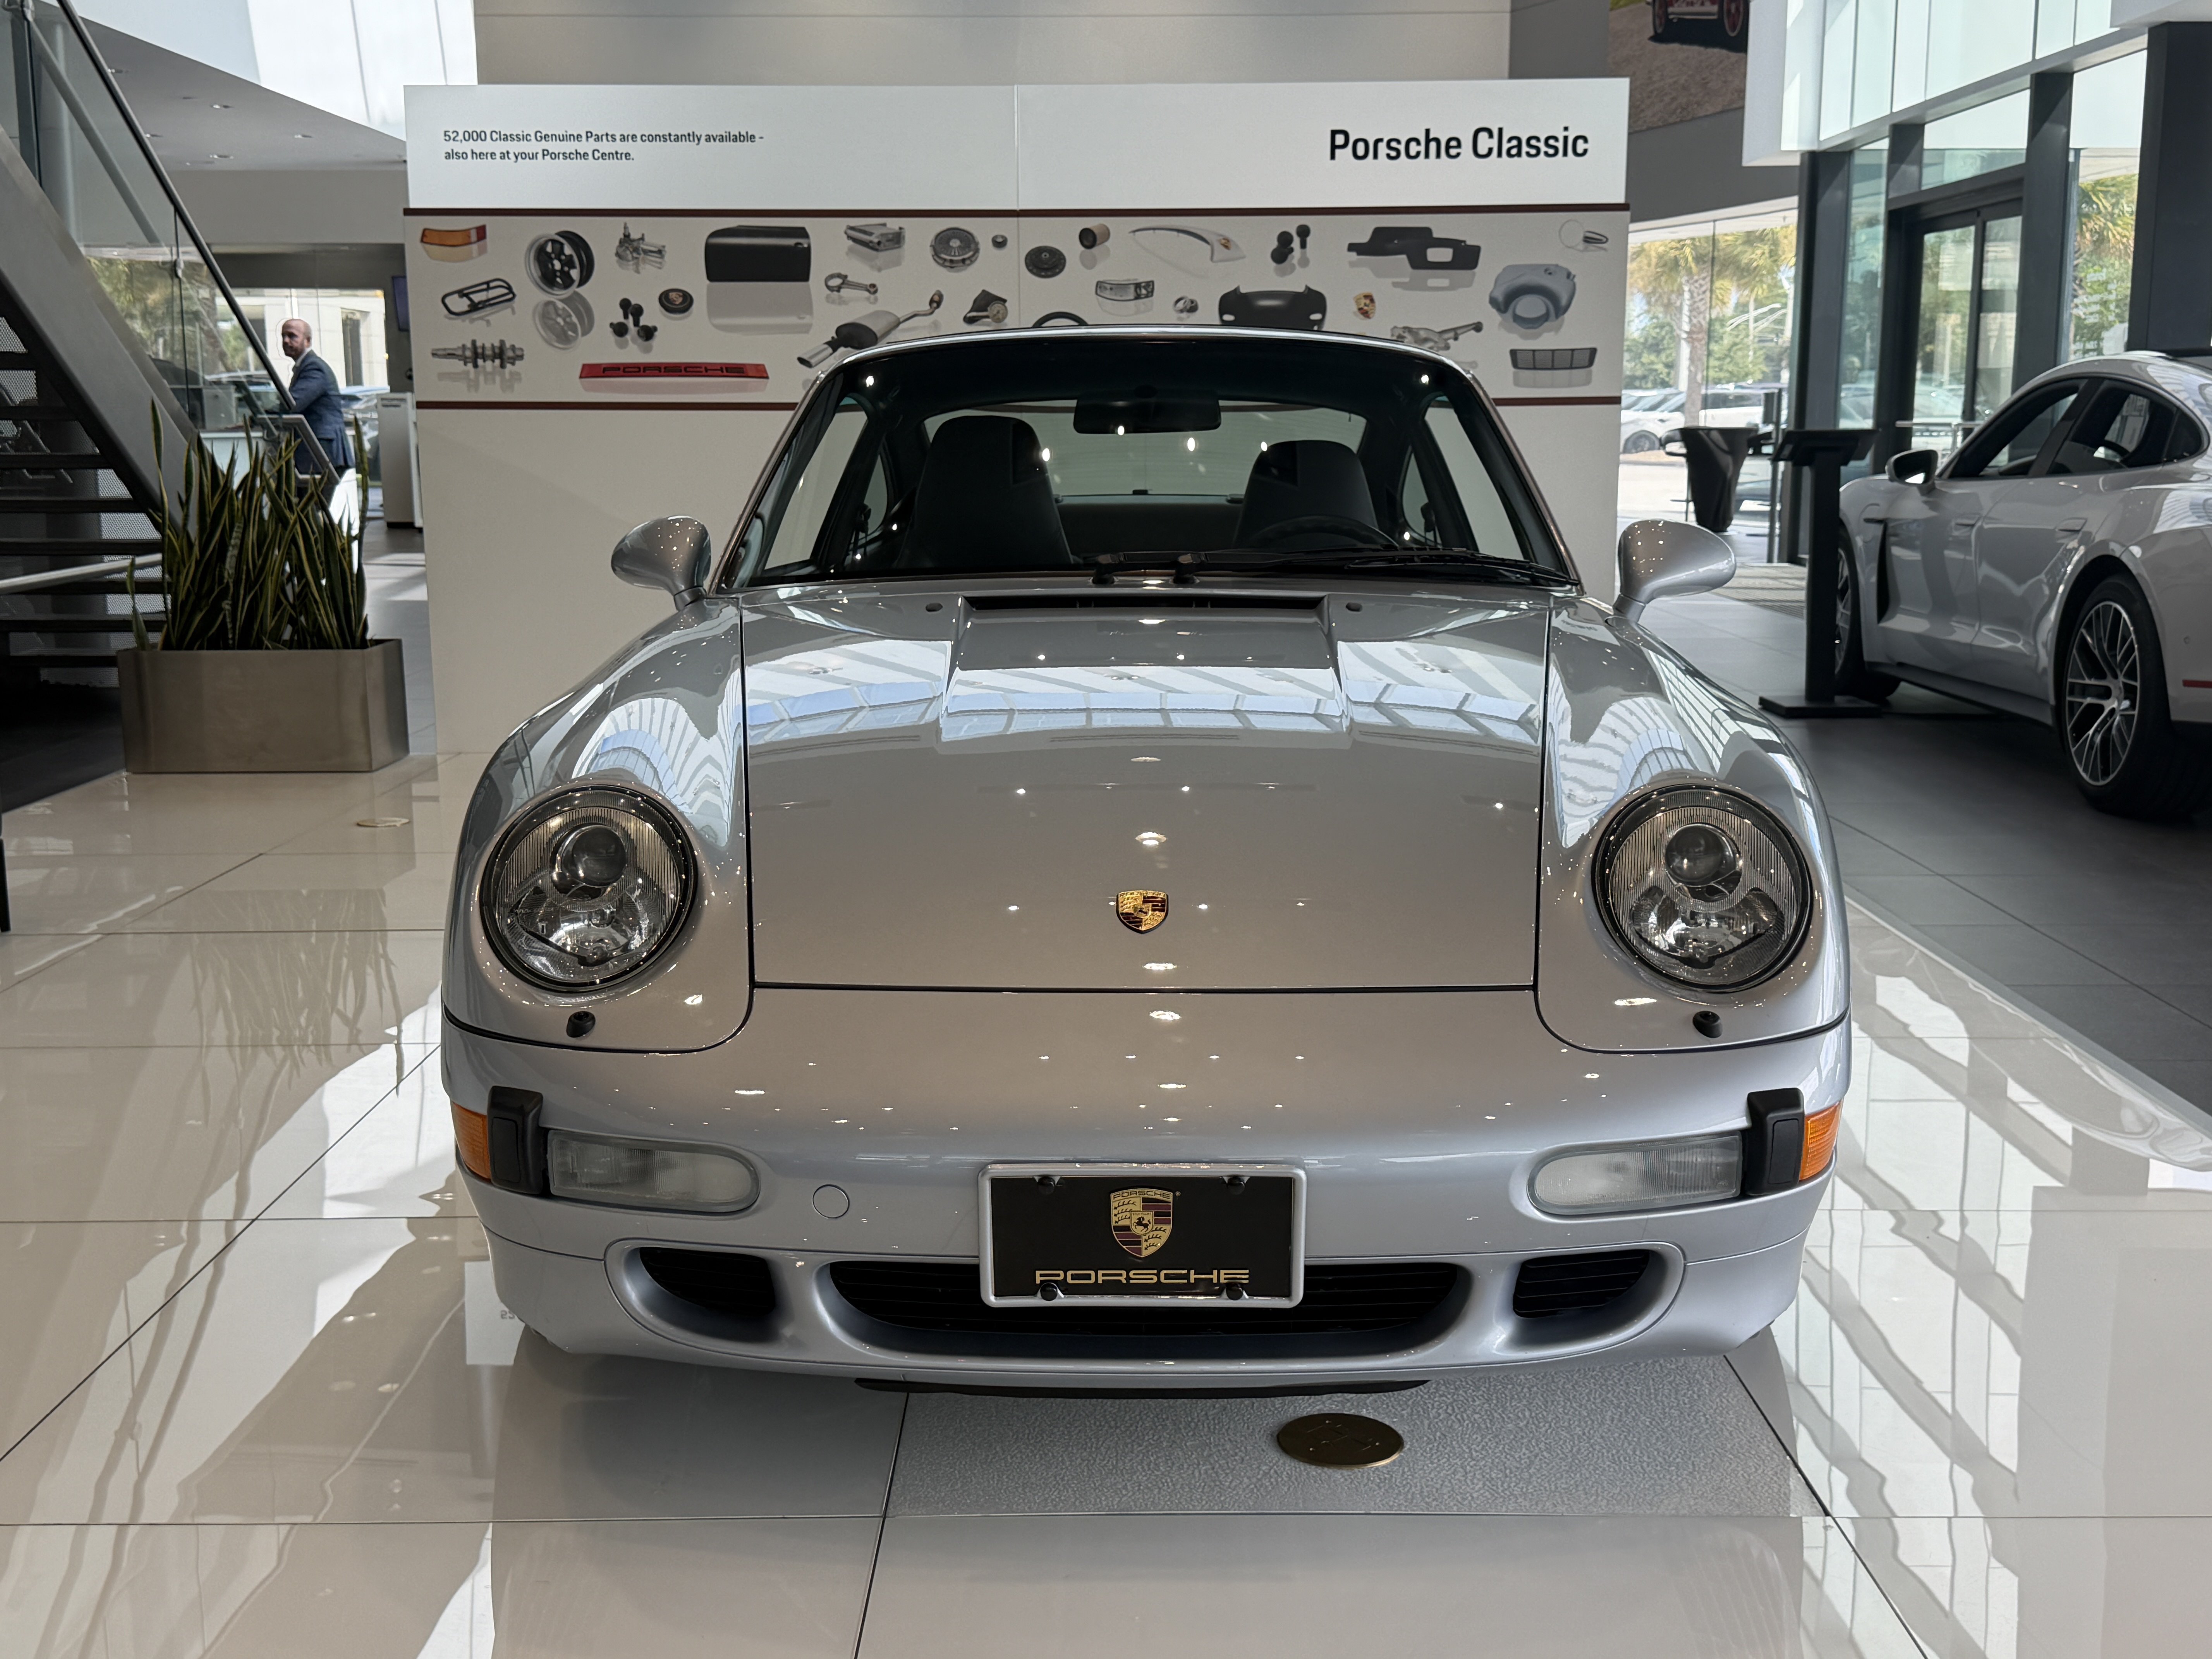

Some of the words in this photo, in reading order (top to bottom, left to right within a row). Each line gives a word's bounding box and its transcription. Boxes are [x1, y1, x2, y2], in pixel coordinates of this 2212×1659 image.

[444, 130, 487, 143] 52,000
[490, 130, 532, 142] Classic
[534, 130, 582, 142] Genuine
[586, 131, 617, 143] Parts
[619, 134, 637, 143] are
[640, 131, 702, 146] constantly
[705, 131, 756, 143] available
[1330, 128, 1462, 161] Porsche
[1472, 126, 1589, 159] Classic
[445, 148, 468, 160] also
[471, 149, 496, 160] here
[500, 150, 511, 160] at
[513, 151, 539, 163] your
[542, 149, 589, 160] Porsche
[592, 149, 634, 161] Centre.
[602, 366, 745, 374] PORSCHE
[1113, 1190, 1170, 1200] PORSCHE
[1036, 1270, 1249, 1284] PORSCHE
